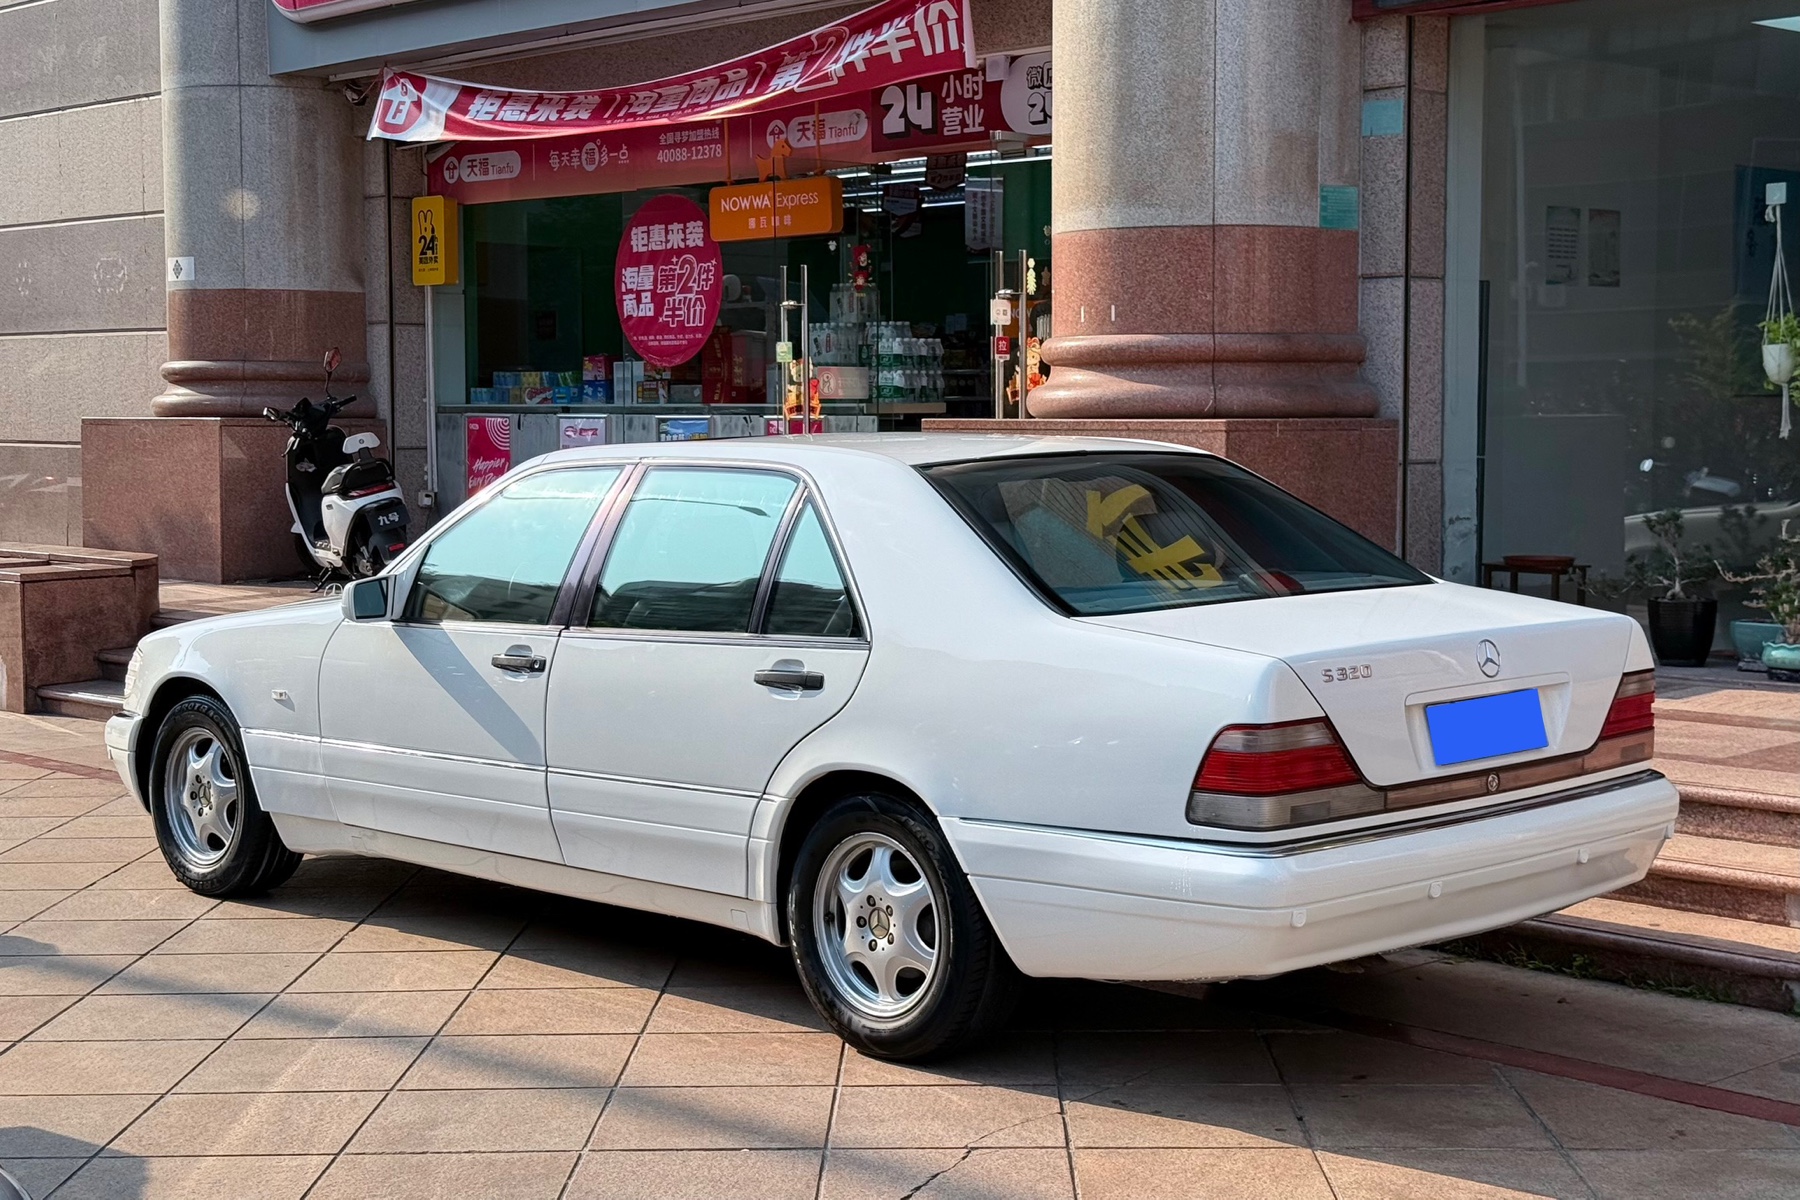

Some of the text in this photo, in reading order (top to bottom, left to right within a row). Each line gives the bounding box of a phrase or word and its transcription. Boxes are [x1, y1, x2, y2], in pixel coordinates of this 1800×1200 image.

[941, 71, 985, 103] 小时
[879, 84, 934, 135] 24
[942, 103, 985, 136] 营业
[659, 127, 719, 146] 全国寻梦加盟热线
[797, 119, 859, 142] 天福 Tianfu
[656, 144, 722, 164] 40088-12378
[467, 158, 514, 178] 天福 Tianfu
[721, 191, 819, 213] NOWWA Express
[622, 265, 655, 293] 海量
[622, 292, 655, 318] 商品
[663, 294, 707, 327] 半价
[998, 340, 1008, 351] 拉
[377, 512, 400, 526] 九号
